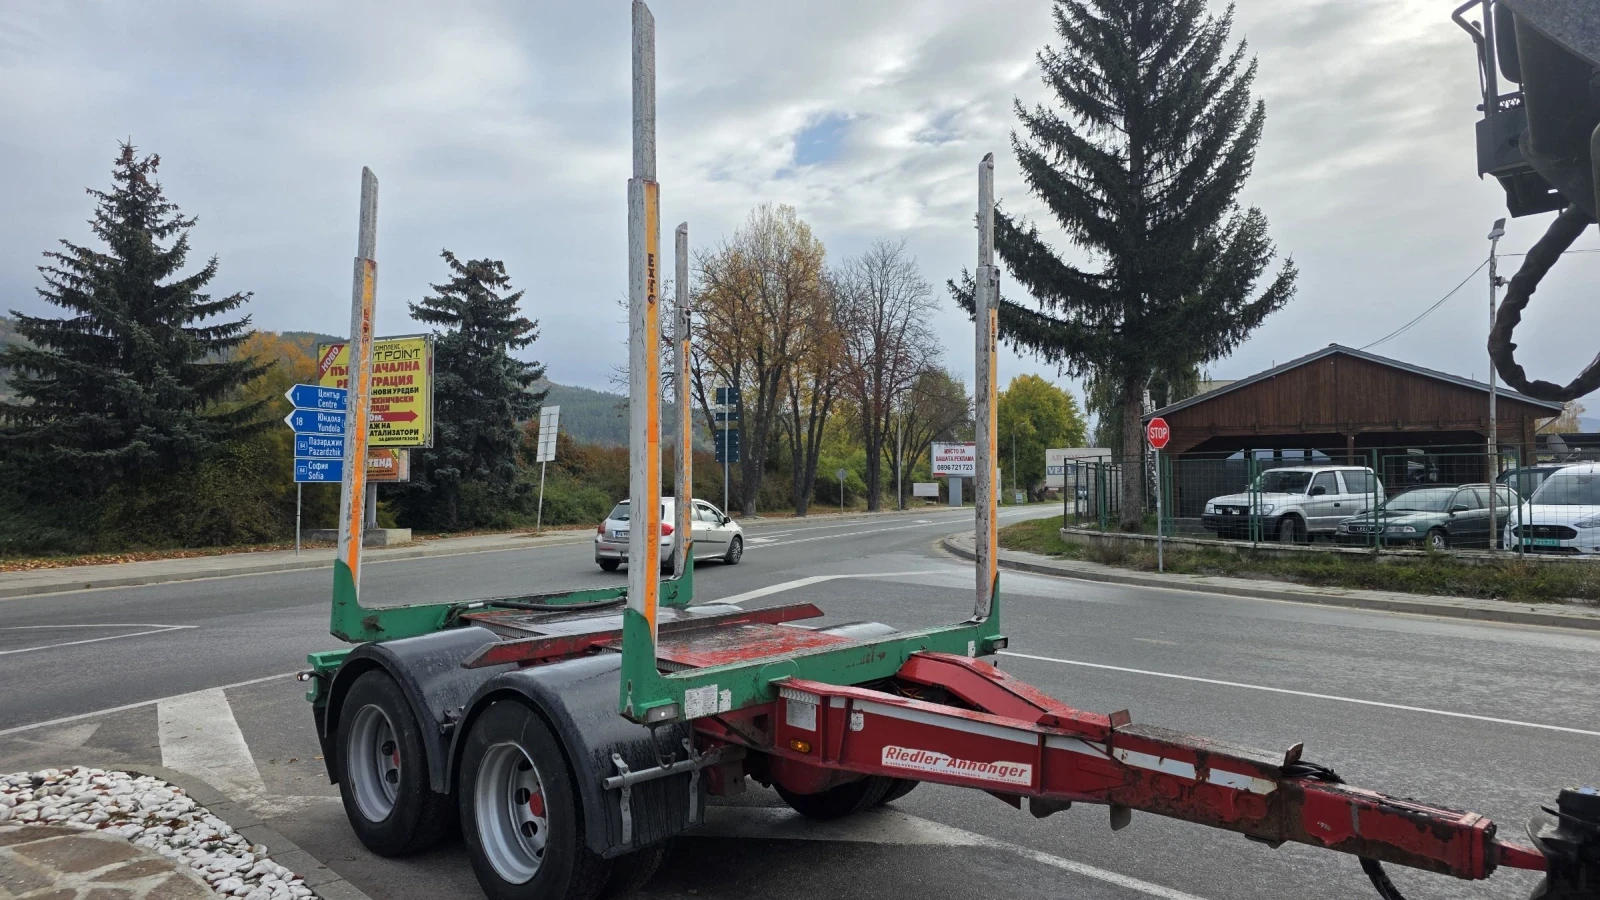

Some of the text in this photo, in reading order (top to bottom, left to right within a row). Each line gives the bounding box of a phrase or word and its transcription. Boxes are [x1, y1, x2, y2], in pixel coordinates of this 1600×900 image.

[321, 346, 339, 371] НОВО
[384, 348, 421, 360] POINT
[317, 388, 340, 401] Център
[317, 398, 338, 409] Centre
[296, 417, 304, 426] 18
[317, 412, 341, 423] Юндола
[317, 422, 341, 433] Yundola
[369, 428, 419, 437] АТАЛИЗАТОРИ
[1150, 427, 1167, 439] STOP
[308, 436, 343, 448] Пазарджик
[308, 446, 341, 456] Pazardzhik
[308, 460, 329, 470] София
[367, 457, 393, 469] ТЕНД
[308, 471, 324, 480] Sofia
